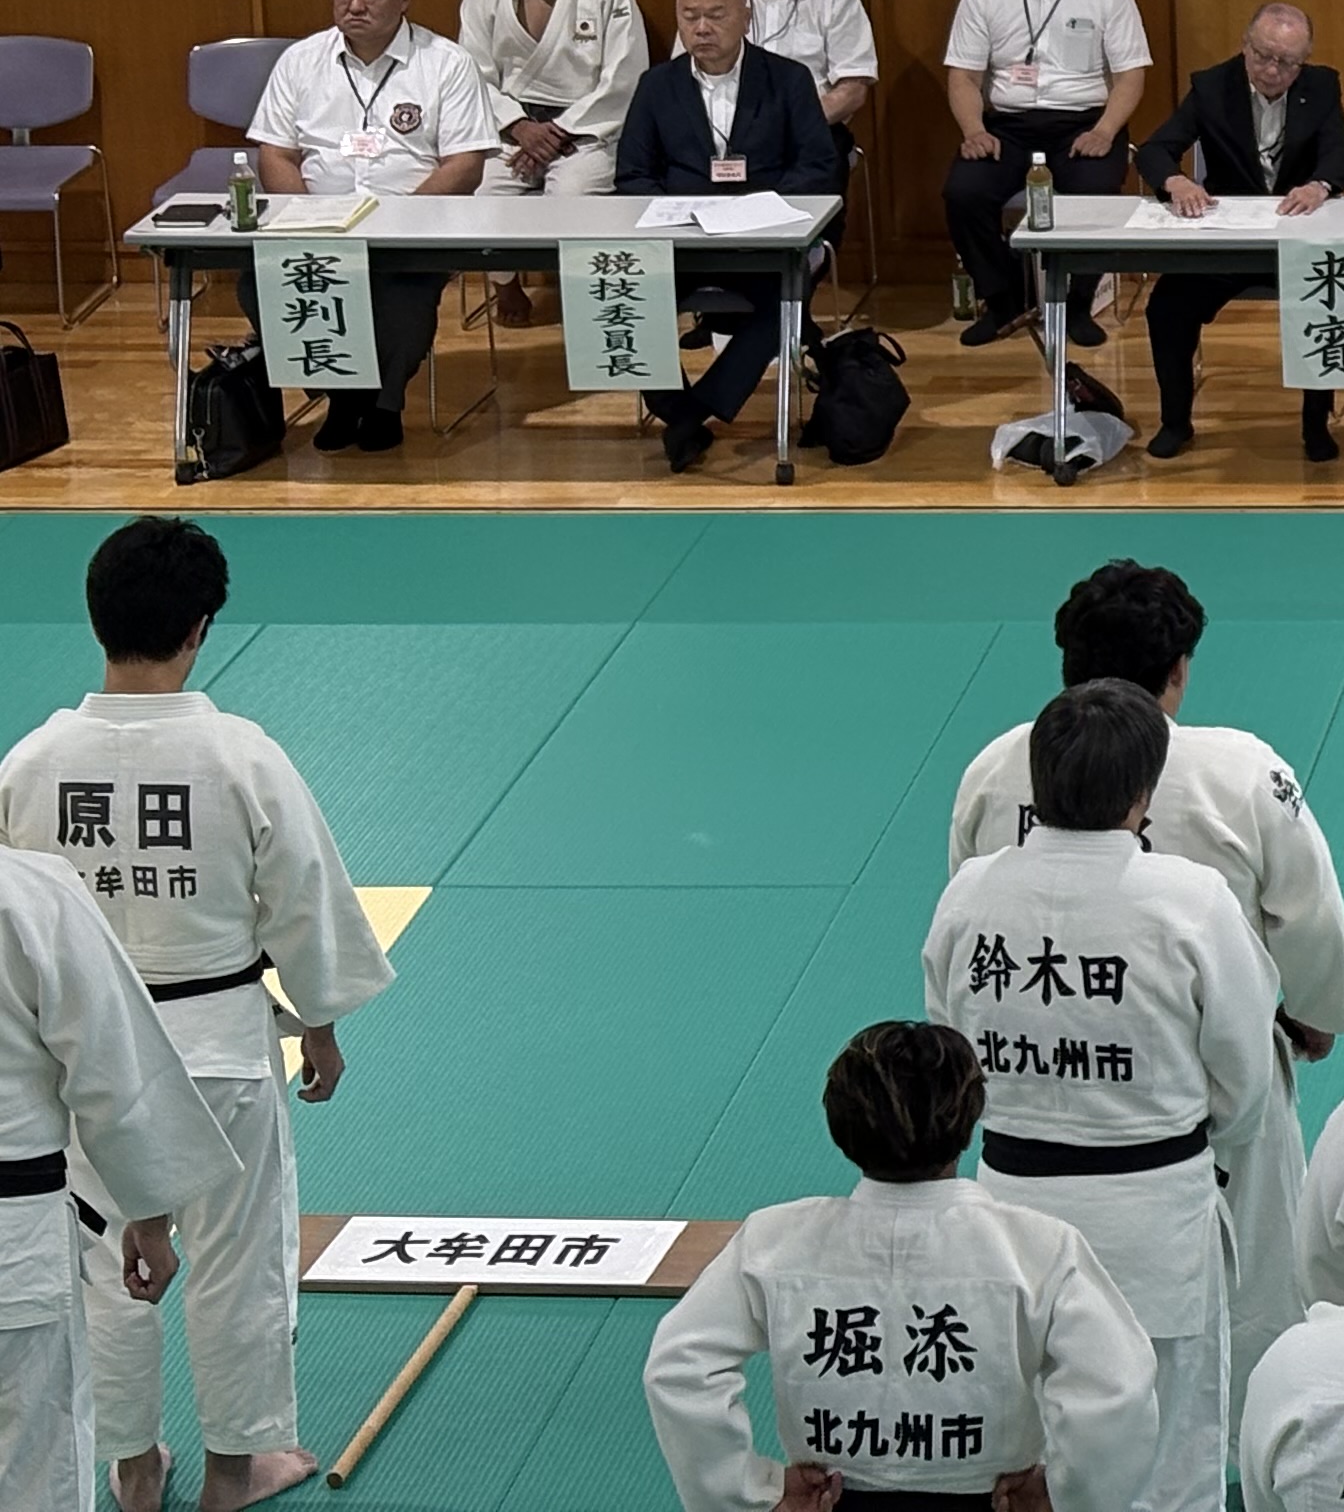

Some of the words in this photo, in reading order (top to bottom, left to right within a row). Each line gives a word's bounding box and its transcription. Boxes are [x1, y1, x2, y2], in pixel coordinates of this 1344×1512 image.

[281, 252, 358, 377] 審判長
[588, 251, 651, 378] 競技委員長
[57, 782, 193, 851] 原田
[78, 865, 197, 899] 牟田市
[968, 933, 1129, 1007] 鈴木田
[977, 1030, 1133, 1082] 北九州市
[361, 1231, 621, 1268] 大牟田市
[803, 1303, 978, 1383] 堀添
[804, 1408, 984, 1461] 北九州市
